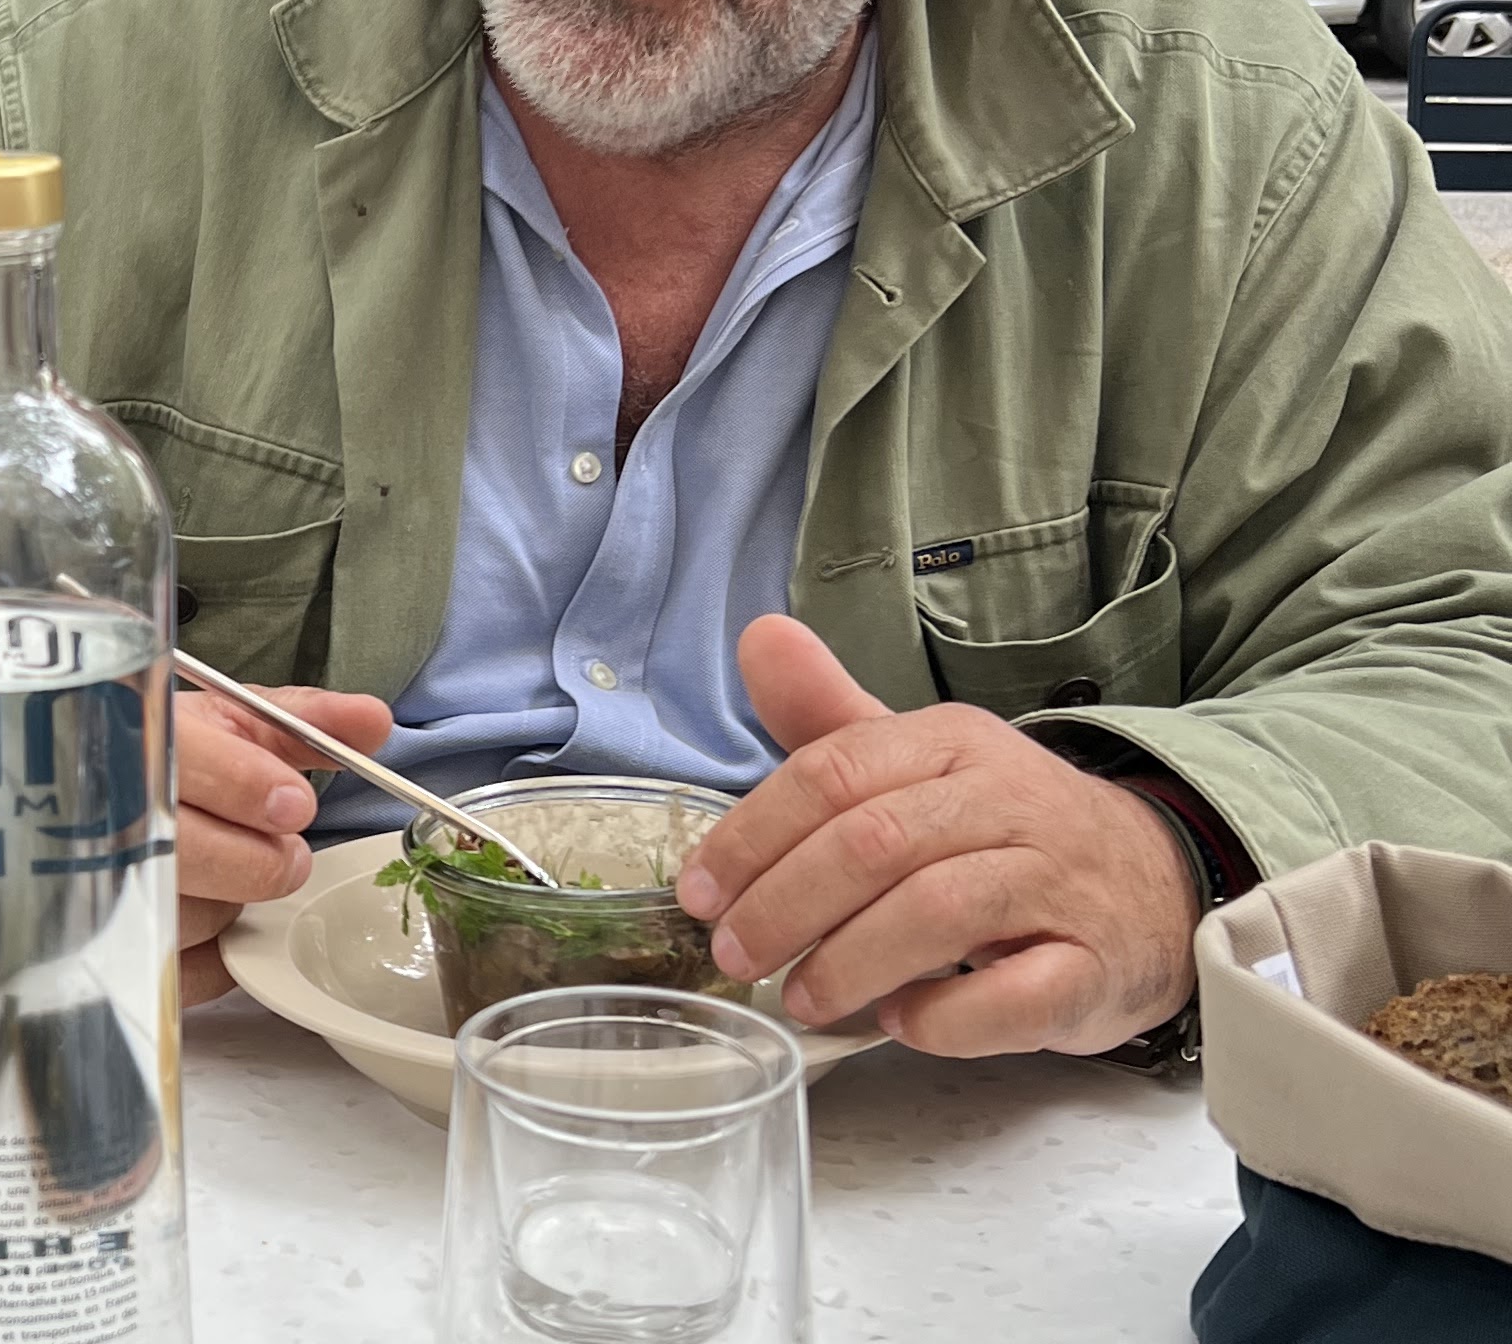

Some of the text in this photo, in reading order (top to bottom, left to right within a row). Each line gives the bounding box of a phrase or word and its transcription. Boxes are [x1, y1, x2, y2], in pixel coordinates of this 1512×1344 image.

[917, 549, 960, 569] Polo
[27, 1281, 47, 1294] gaz
[60, 1293, 81, 1304] aux
[84, 1286, 97, 1299] 15
[84, 1304, 99, 1315] en
[105, 1290, 137, 1309] France
[1, 1331, 15, 1341] et
[100, 1315, 117, 1327] sur
[121, 1307, 138, 1320] des
